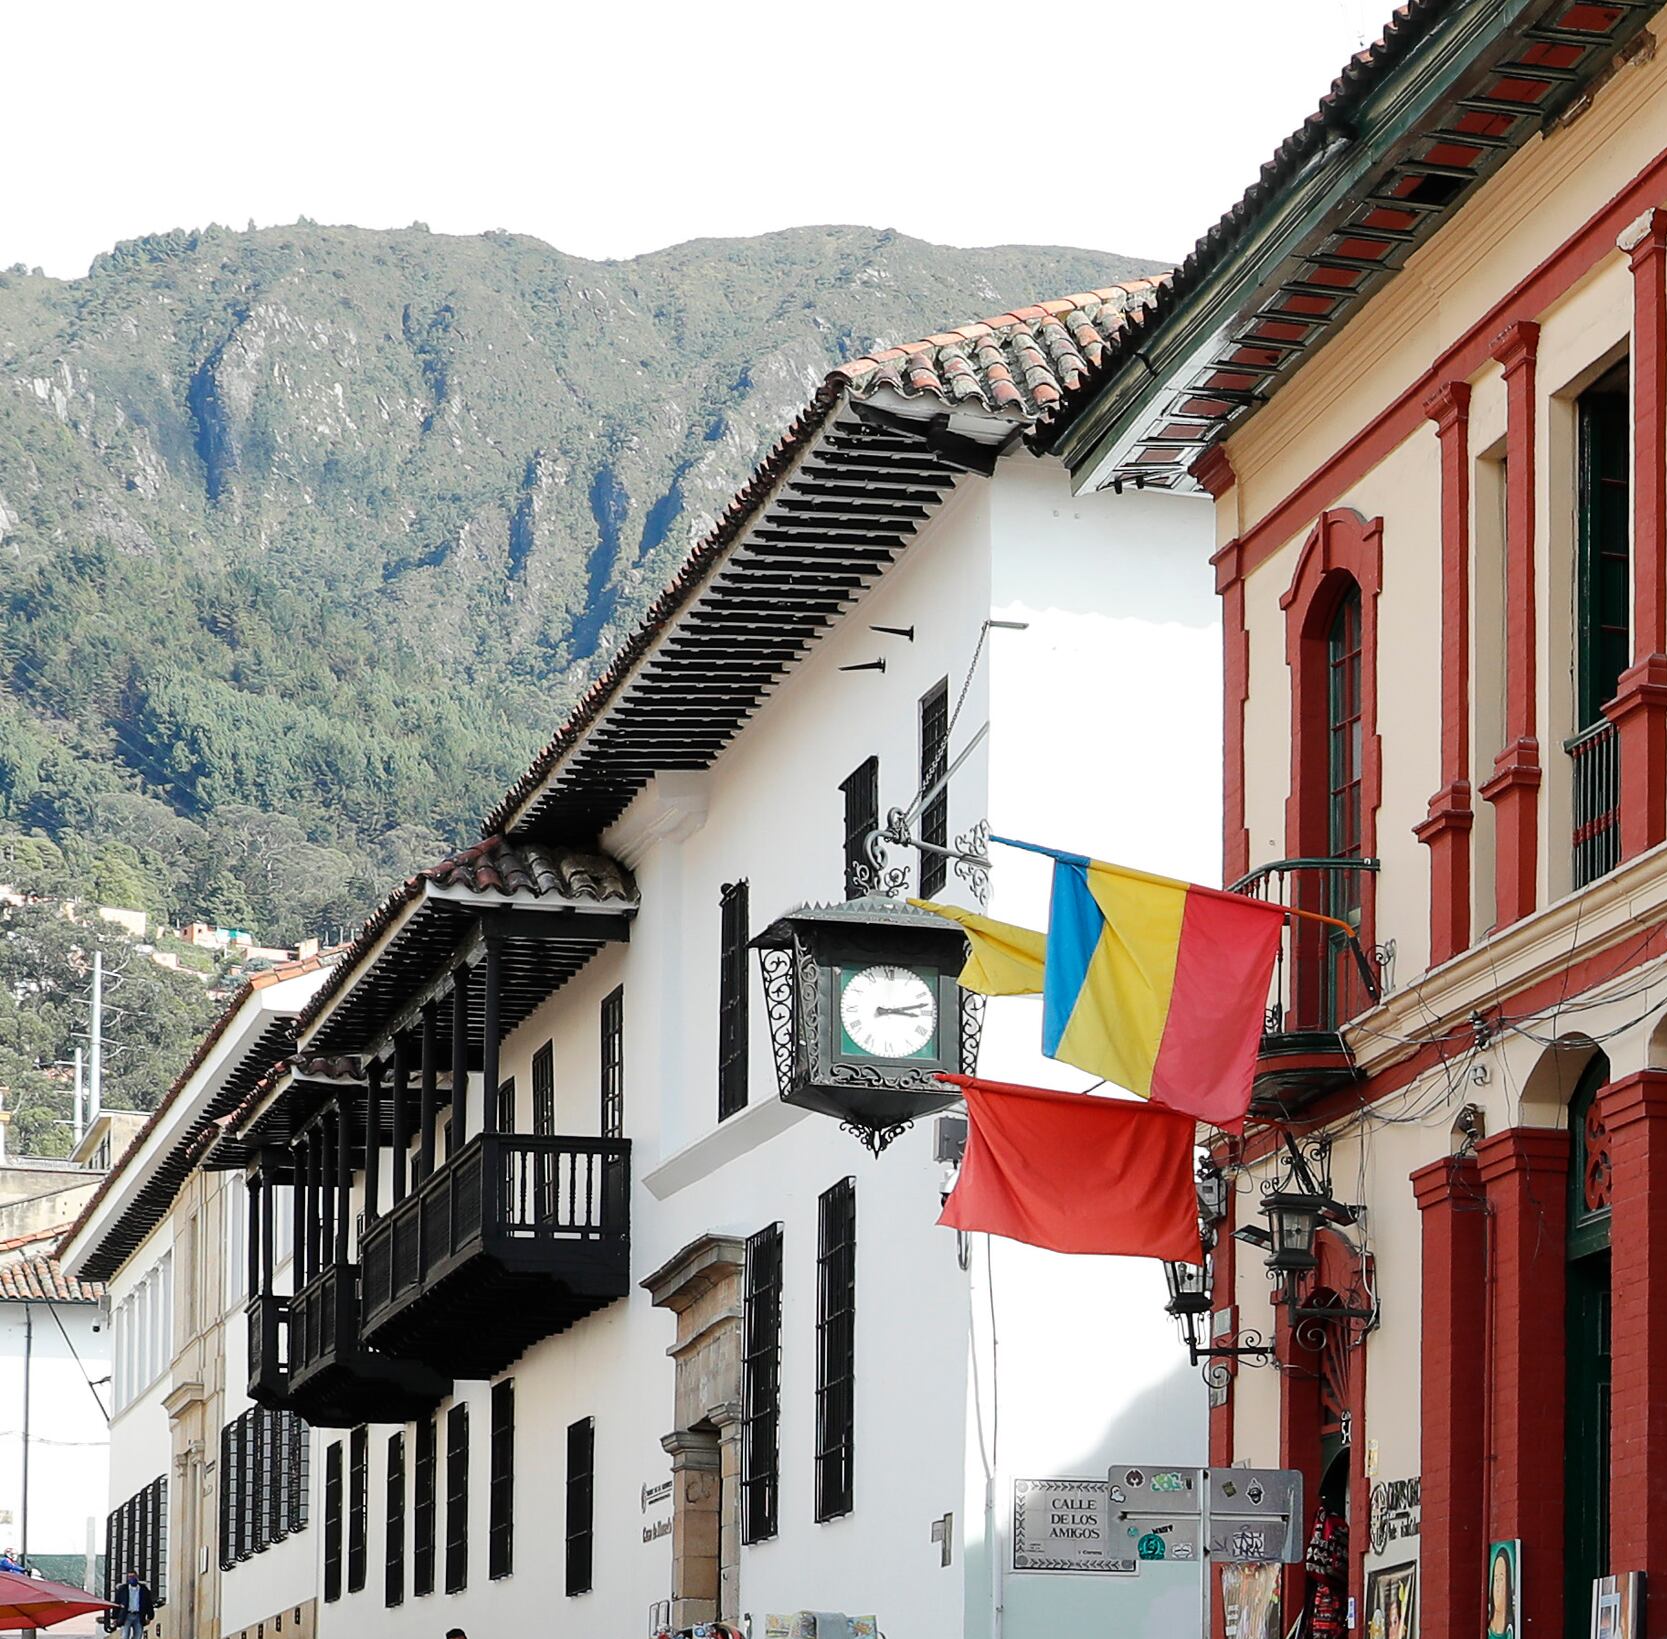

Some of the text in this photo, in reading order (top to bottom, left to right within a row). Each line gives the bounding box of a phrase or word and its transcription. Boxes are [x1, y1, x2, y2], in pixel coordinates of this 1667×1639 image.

[1051, 1498, 1097, 1510] CALLE
[1050, 1513, 1098, 1526] DE LOS
[1049, 1527, 1101, 1539] AMIGOS
